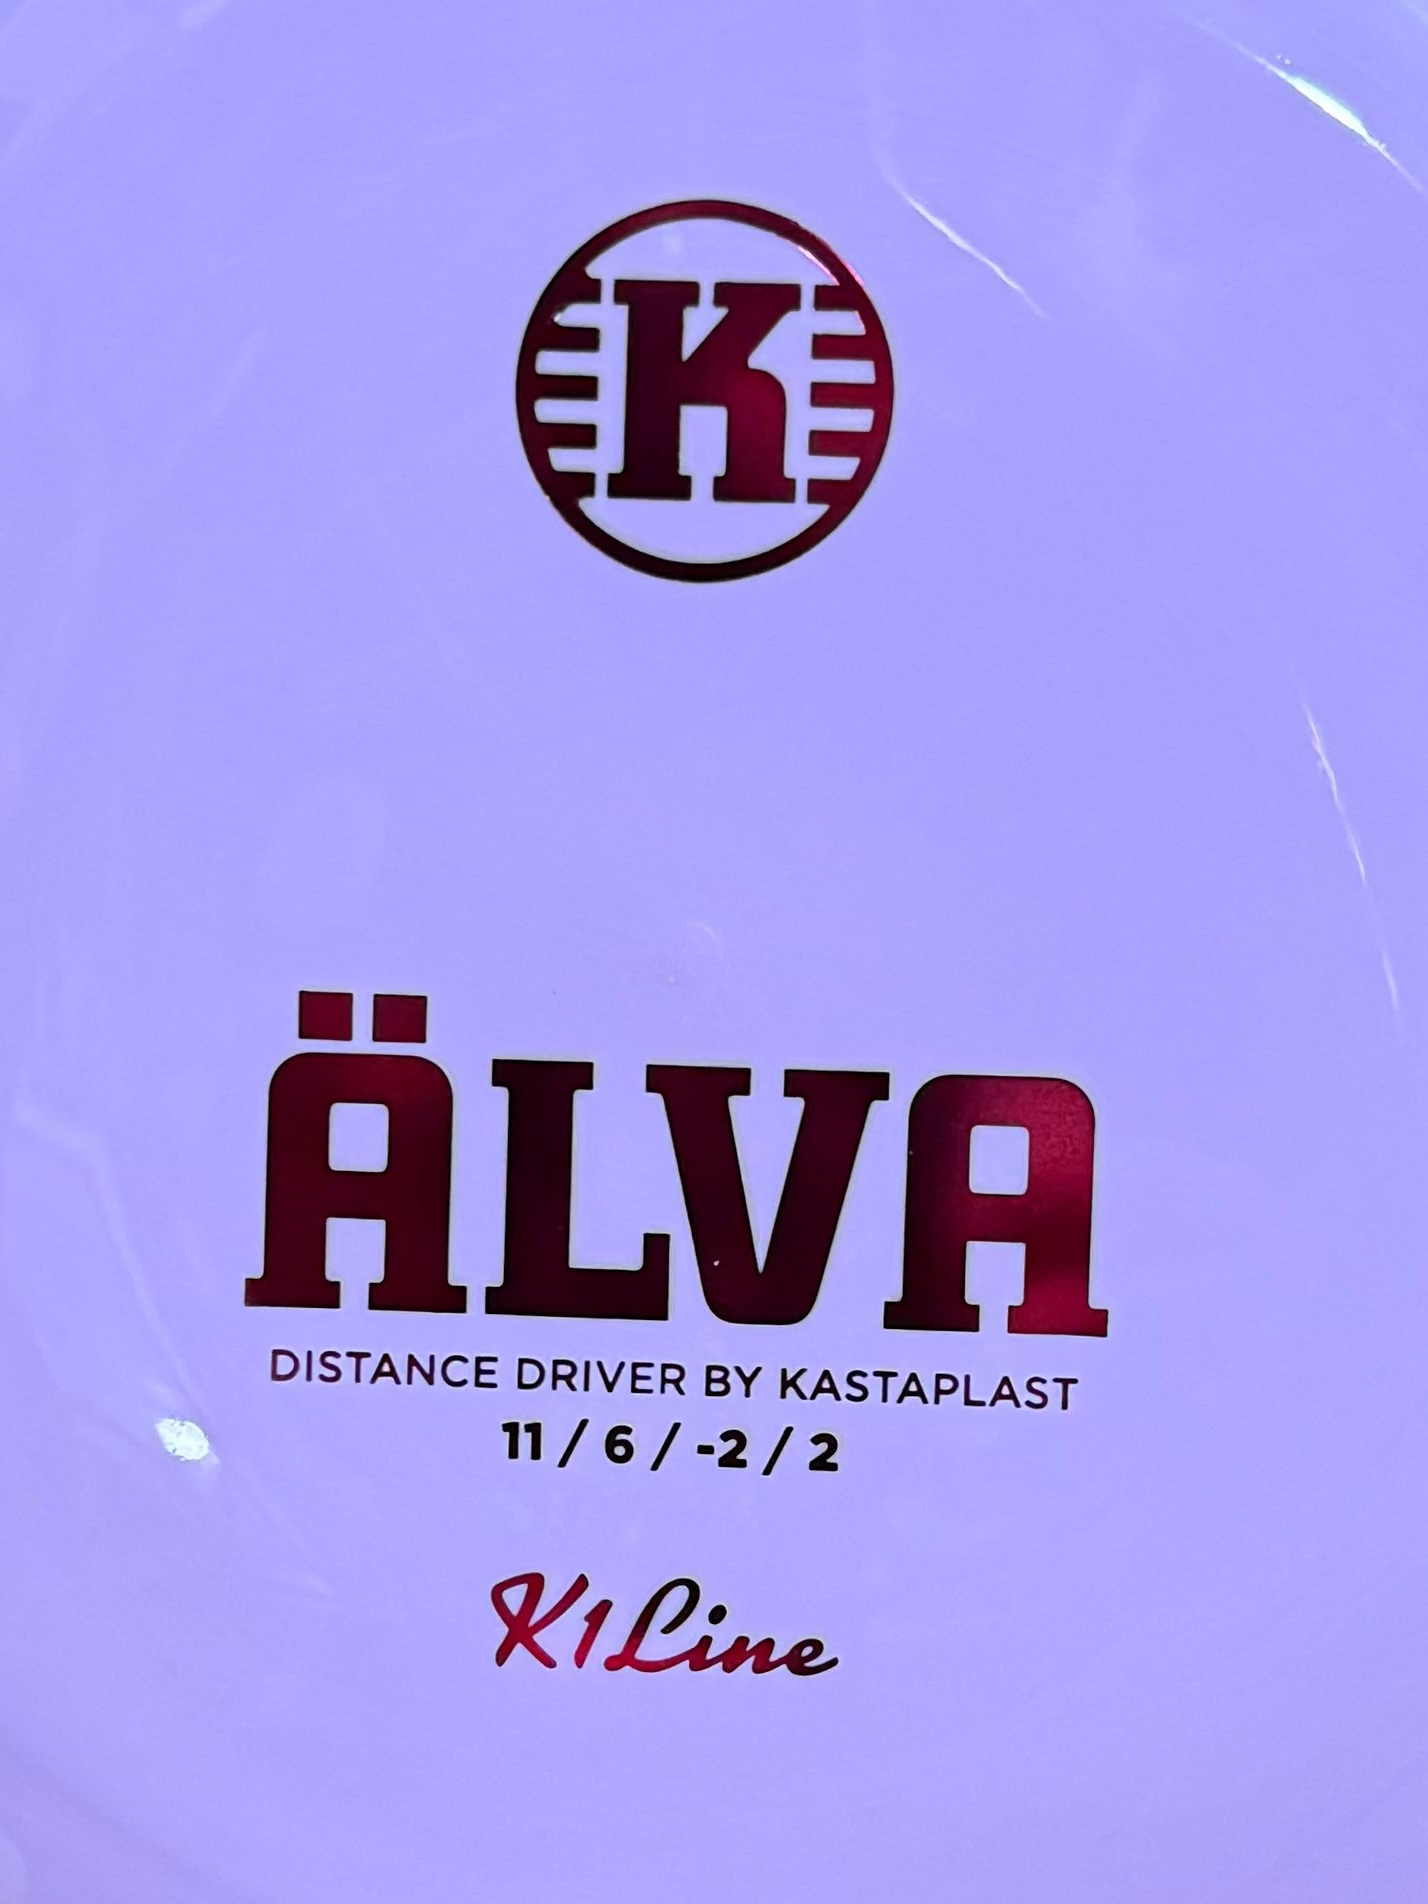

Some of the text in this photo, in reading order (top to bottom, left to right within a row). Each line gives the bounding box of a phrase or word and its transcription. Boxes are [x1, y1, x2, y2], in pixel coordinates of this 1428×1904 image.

[606, 278, 802, 504] K
[243, 989, 1110, 1338] ÄLVA
[269, 1348, 1080, 1412] DISTANCE DRIVER BY KASTAPLAST
[500, 1421, 543, 1462] 11
[603, 1424, 636, 1466] 6
[695, 1429, 749, 1470] -2
[807, 1432, 840, 1473] 2
